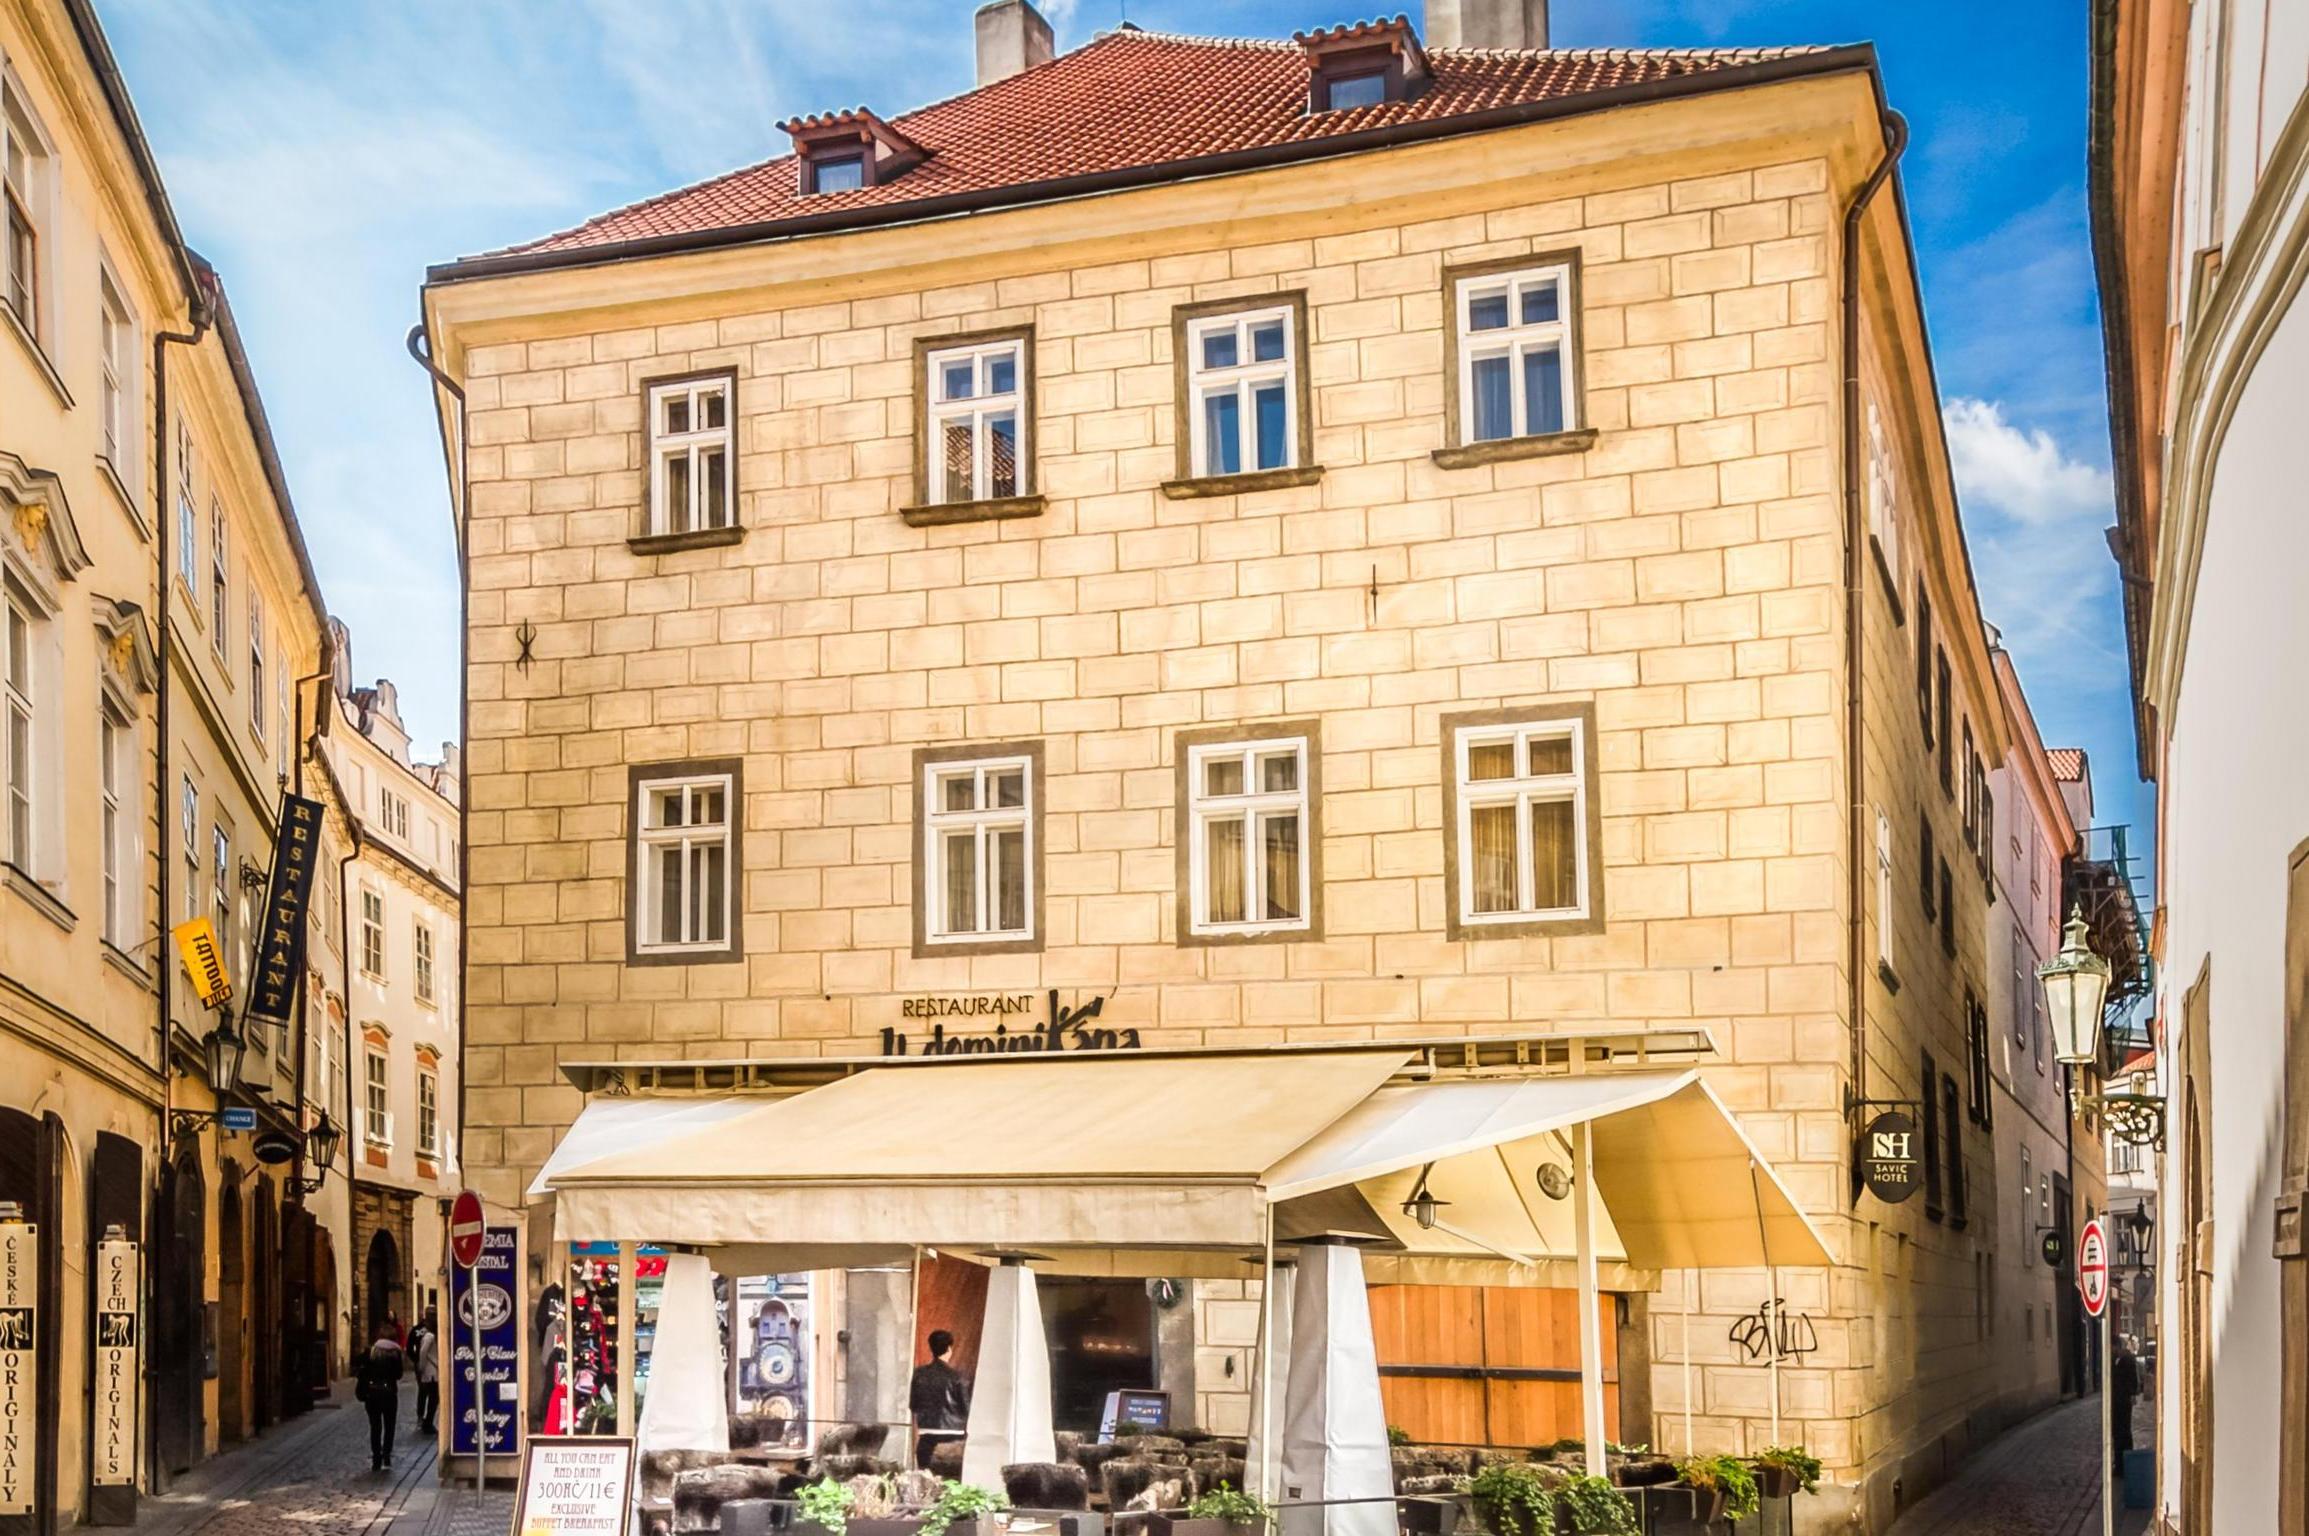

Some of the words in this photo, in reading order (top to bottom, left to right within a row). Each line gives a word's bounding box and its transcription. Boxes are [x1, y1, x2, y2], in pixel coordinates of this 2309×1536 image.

[267, 804, 312, 1009] RESTAURANT
[192, 932, 223, 992] TATTOO
[902, 995, 1034, 1018] RESTAURANT
[1873, 1173, 1909, 1183] HOTEL
[1875, 1163, 1908, 1174] SAVIC
[6, 1235, 18, 1306] ČESKÉ
[107, 1255, 127, 1311] CZECH
[464, 1366, 510, 1384] Cystal
[108, 1348, 122, 1475] ORIGINALS
[4, 1354, 19, 1503] ORIGINÁLY
[544, 1452, 559, 1465] ALL
[561, 1452, 578, 1465] YOU
[579, 1453, 597, 1465] CAN
[599, 1453, 616, 1465] EAT
[553, 1467, 573, 1479] AND
[574, 1467, 601, 1479] DRINK
[551, 1503, 596, 1515] EXCLUSIVE
[564, 1518, 616, 1530] BREAKFAST
